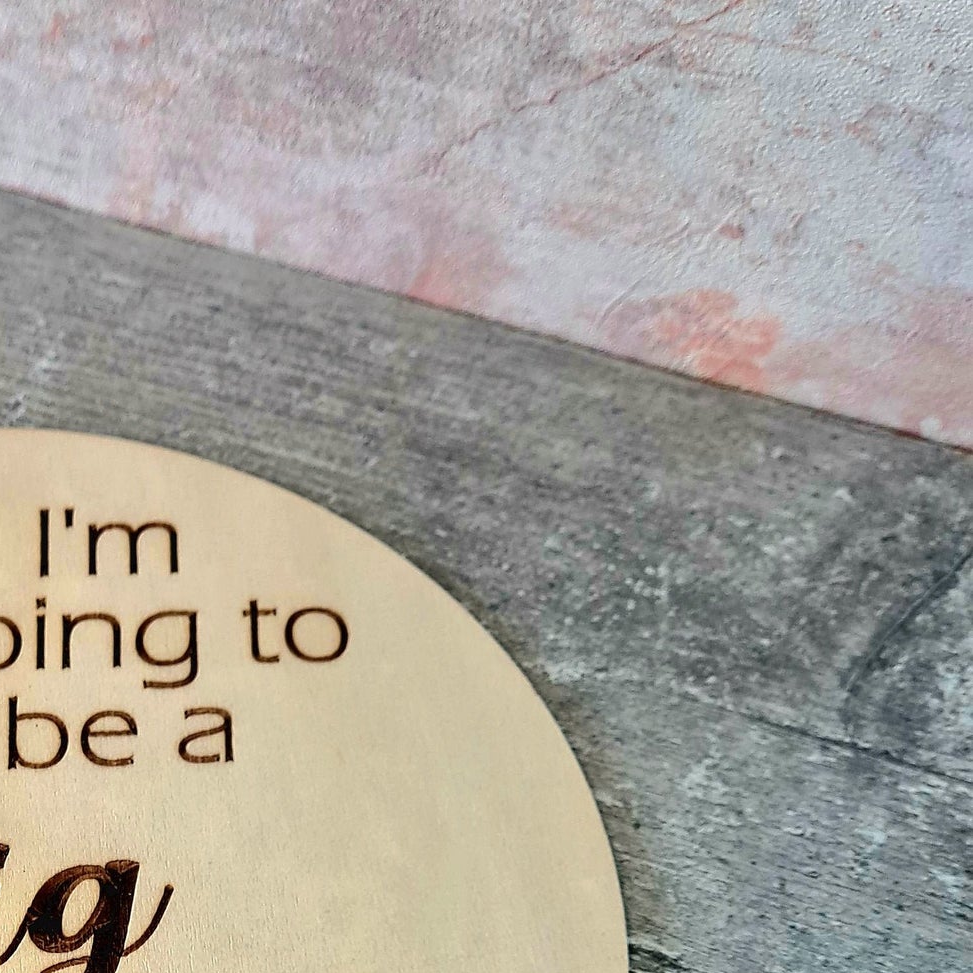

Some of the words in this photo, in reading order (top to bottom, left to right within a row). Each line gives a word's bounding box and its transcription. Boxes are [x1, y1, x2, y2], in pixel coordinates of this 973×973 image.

[38, 507, 179, 579] I'm
[241, 598, 350, 665] to
[7, 695, 139, 770] be
[177, 706, 235, 765] a
